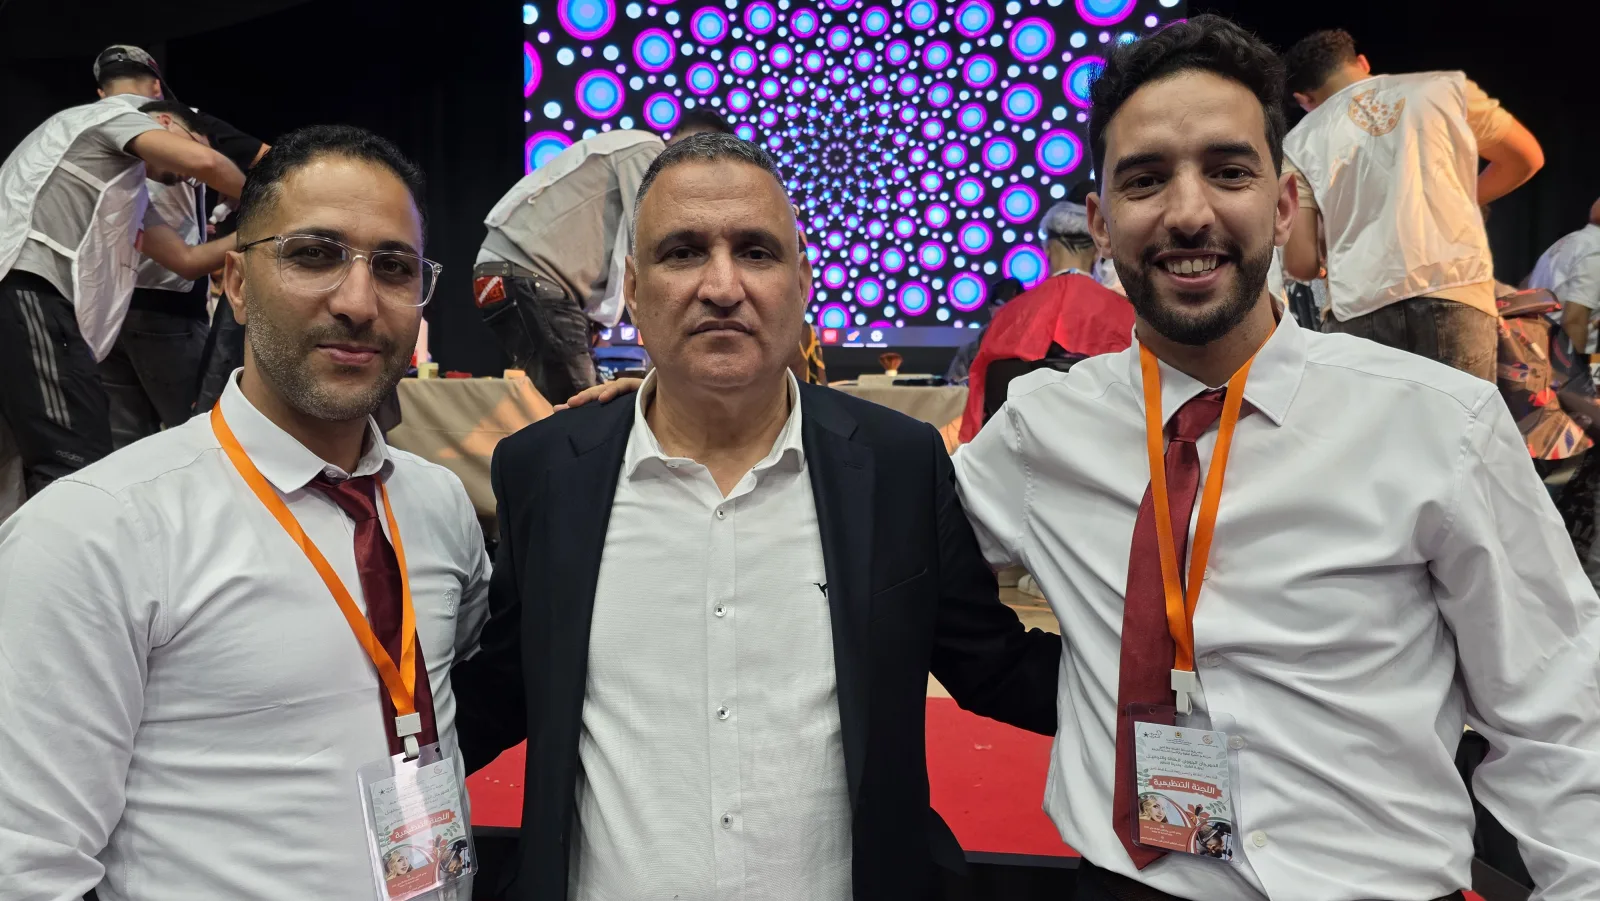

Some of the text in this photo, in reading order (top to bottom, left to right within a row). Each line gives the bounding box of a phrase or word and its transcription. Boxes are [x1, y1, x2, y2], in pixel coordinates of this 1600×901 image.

[1153, 778, 1215, 794] اللجنة التنظيمية
[429, 812, 450, 825] اللجنة
